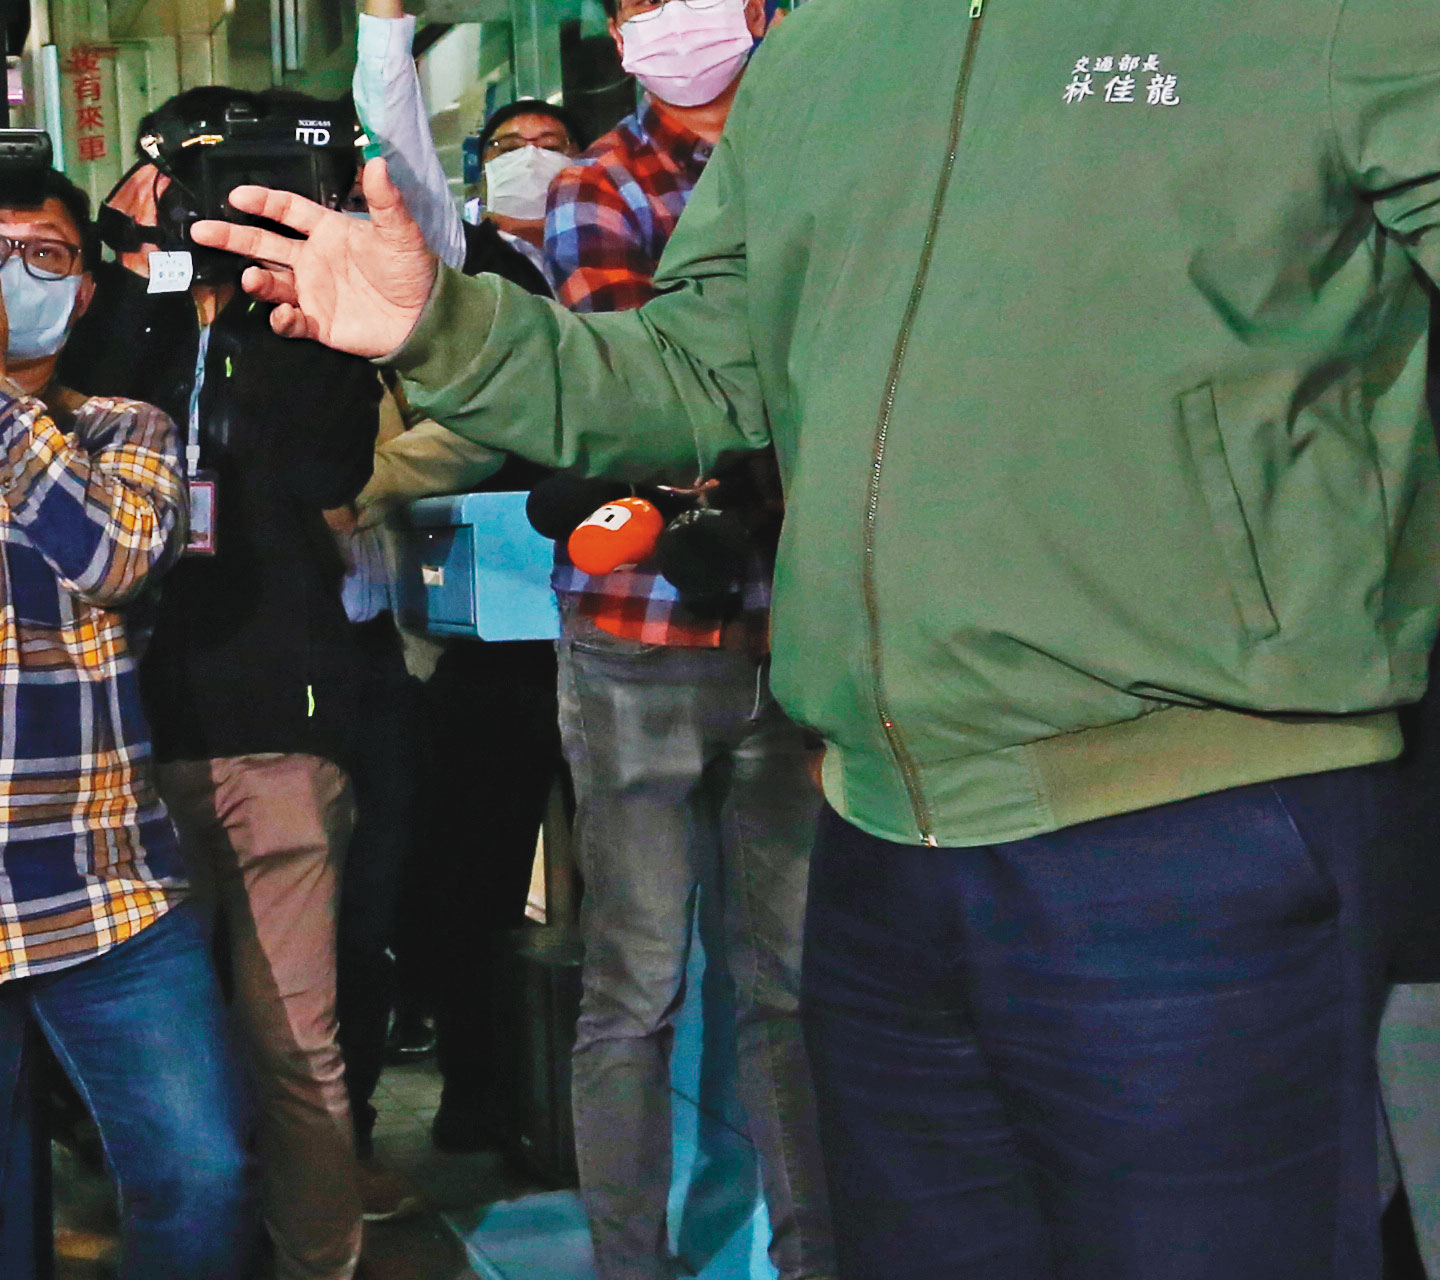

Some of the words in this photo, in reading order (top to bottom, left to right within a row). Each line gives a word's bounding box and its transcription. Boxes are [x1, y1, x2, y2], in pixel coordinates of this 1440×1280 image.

[1071, 54, 1160, 74] 交通部長
[1062, 73, 1180, 106] 林佳龍
